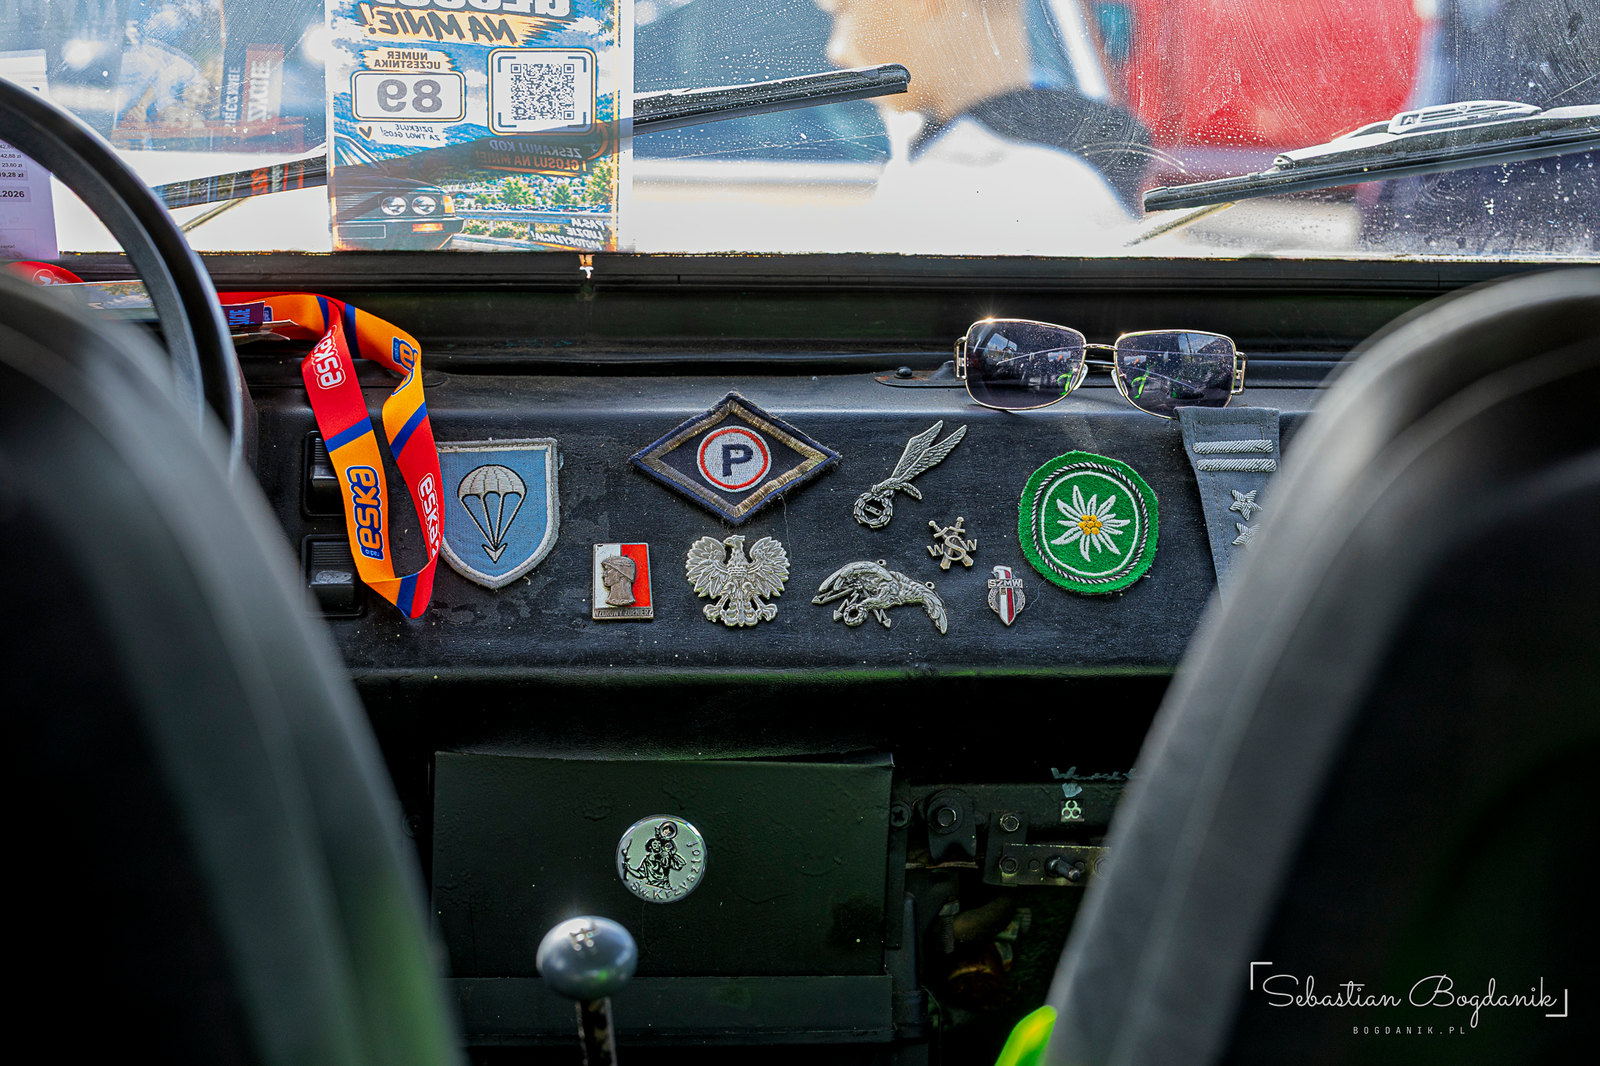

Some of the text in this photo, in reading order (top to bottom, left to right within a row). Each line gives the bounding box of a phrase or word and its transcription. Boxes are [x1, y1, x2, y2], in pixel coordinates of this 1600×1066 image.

[721, 443, 754, 477] P
[349, 468, 381, 549] eska
[988, 579, 1023, 588] SZMW
